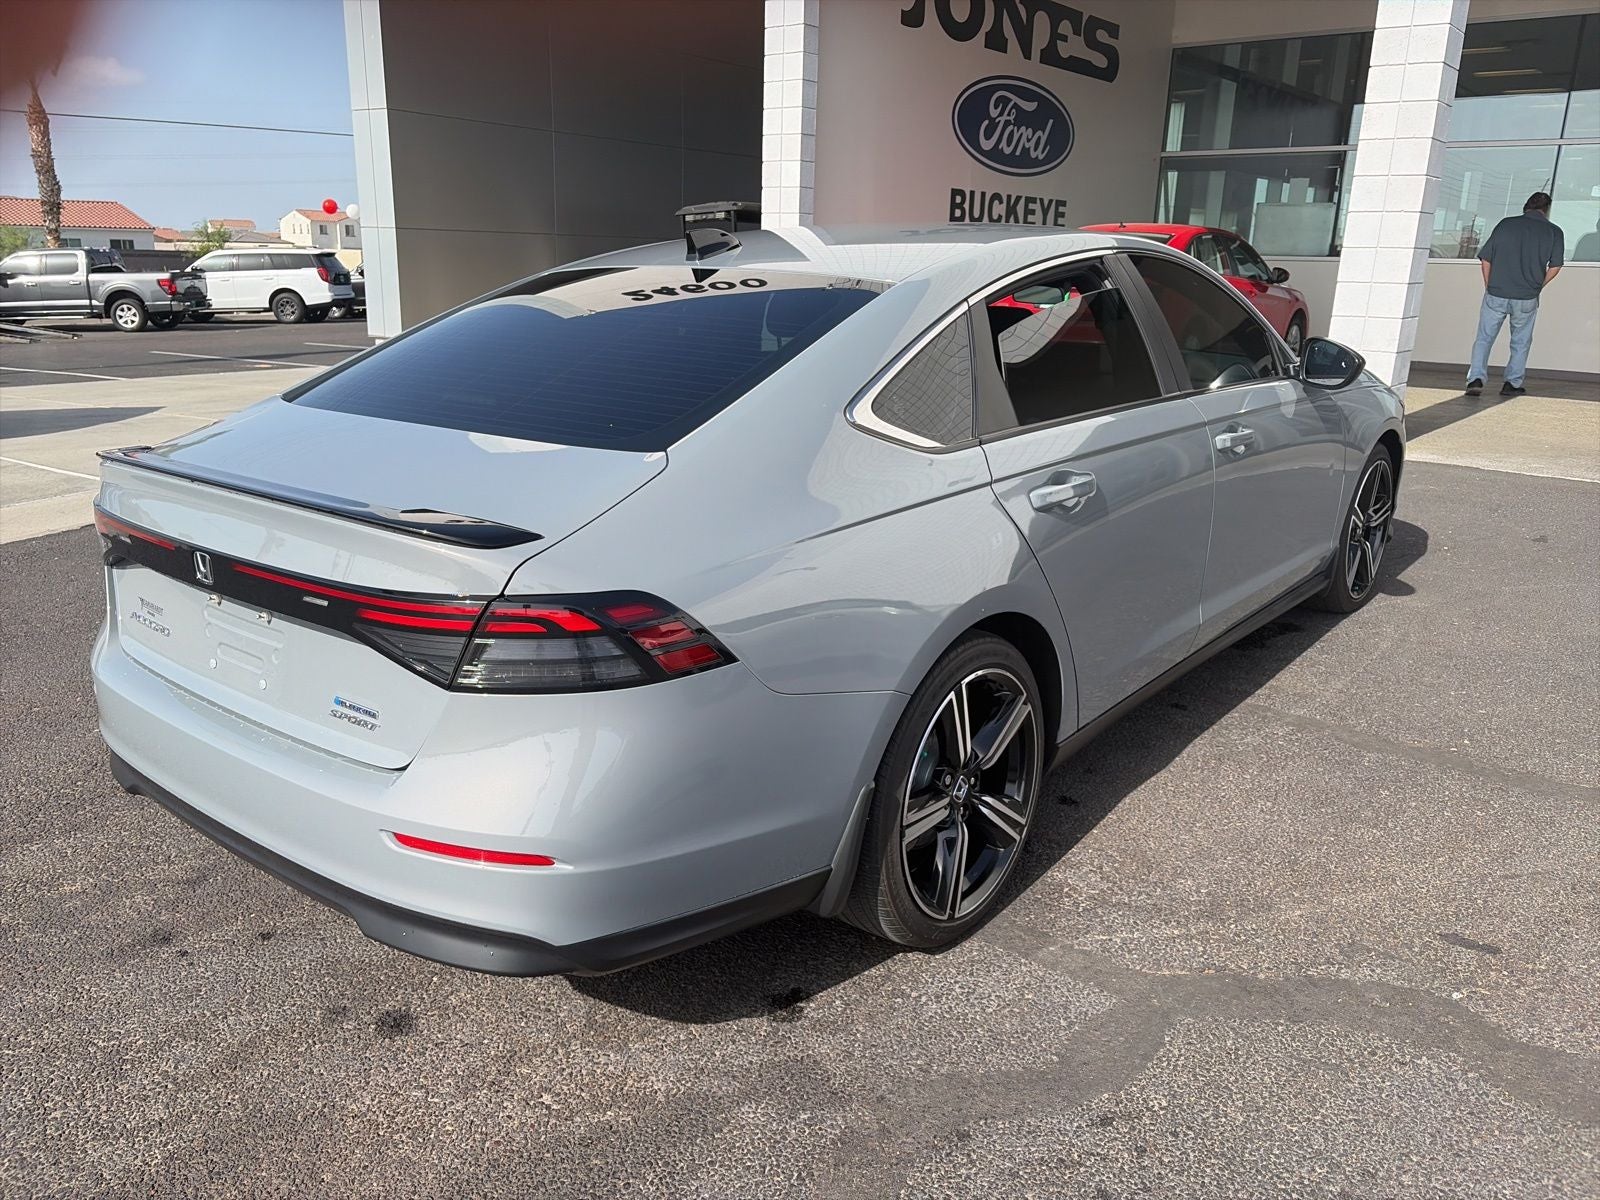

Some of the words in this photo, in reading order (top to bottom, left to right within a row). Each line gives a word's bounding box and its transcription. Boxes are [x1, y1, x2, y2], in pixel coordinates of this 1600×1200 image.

[979, 91, 1053, 160] Ford
[950, 188, 1067, 227] BUCKEYE
[328, 709, 379, 731] SPORT
